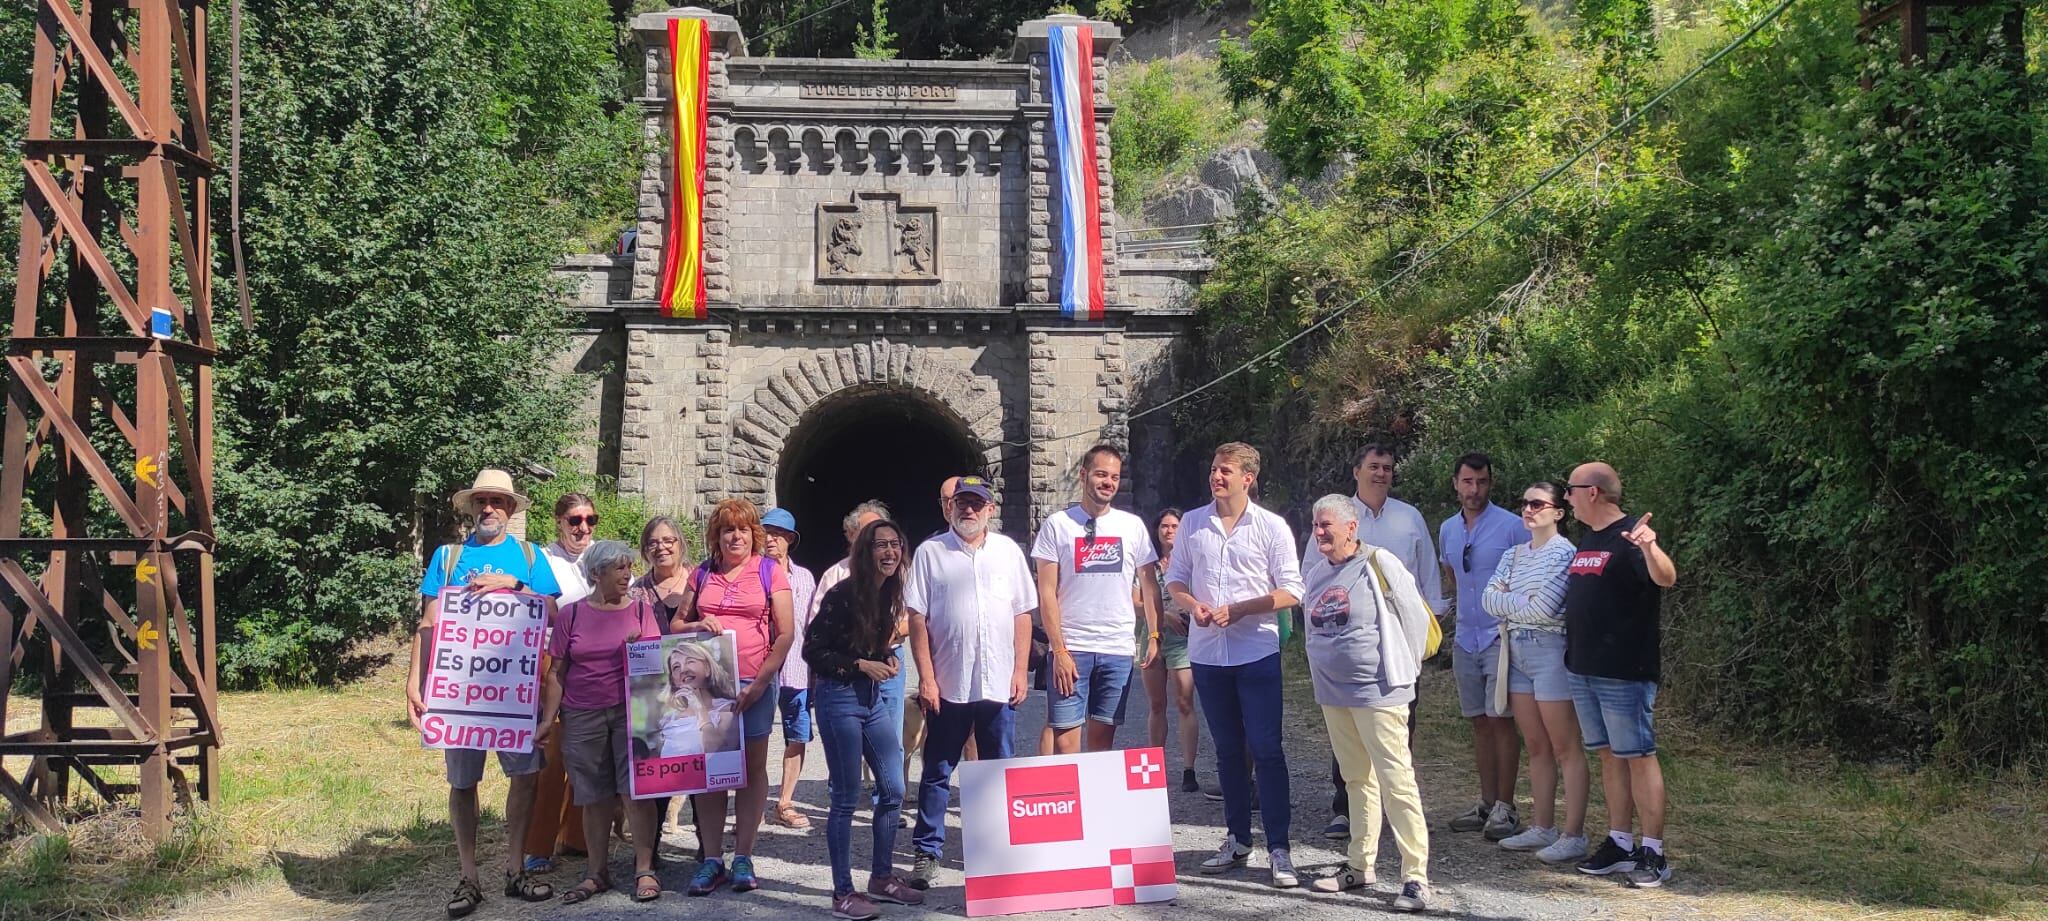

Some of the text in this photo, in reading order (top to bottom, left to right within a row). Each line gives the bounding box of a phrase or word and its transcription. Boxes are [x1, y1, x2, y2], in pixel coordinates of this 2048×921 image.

[806, 84, 856, 97] TUNEL
[876, 84, 952, 98] SOMPORT
[443, 592, 543, 621] Es por ti
[440, 620, 540, 650] Es por ti
[629, 642, 660, 652] Yolanda
[435, 648, 536, 677] Es por ti
[431, 676, 533, 705] Es por ti
[423, 716, 532, 749] Sumar
[636, 756, 704, 779] Es por ti
[709, 776, 741, 786] Sumar
[1012, 799, 1076, 818] Sumar
